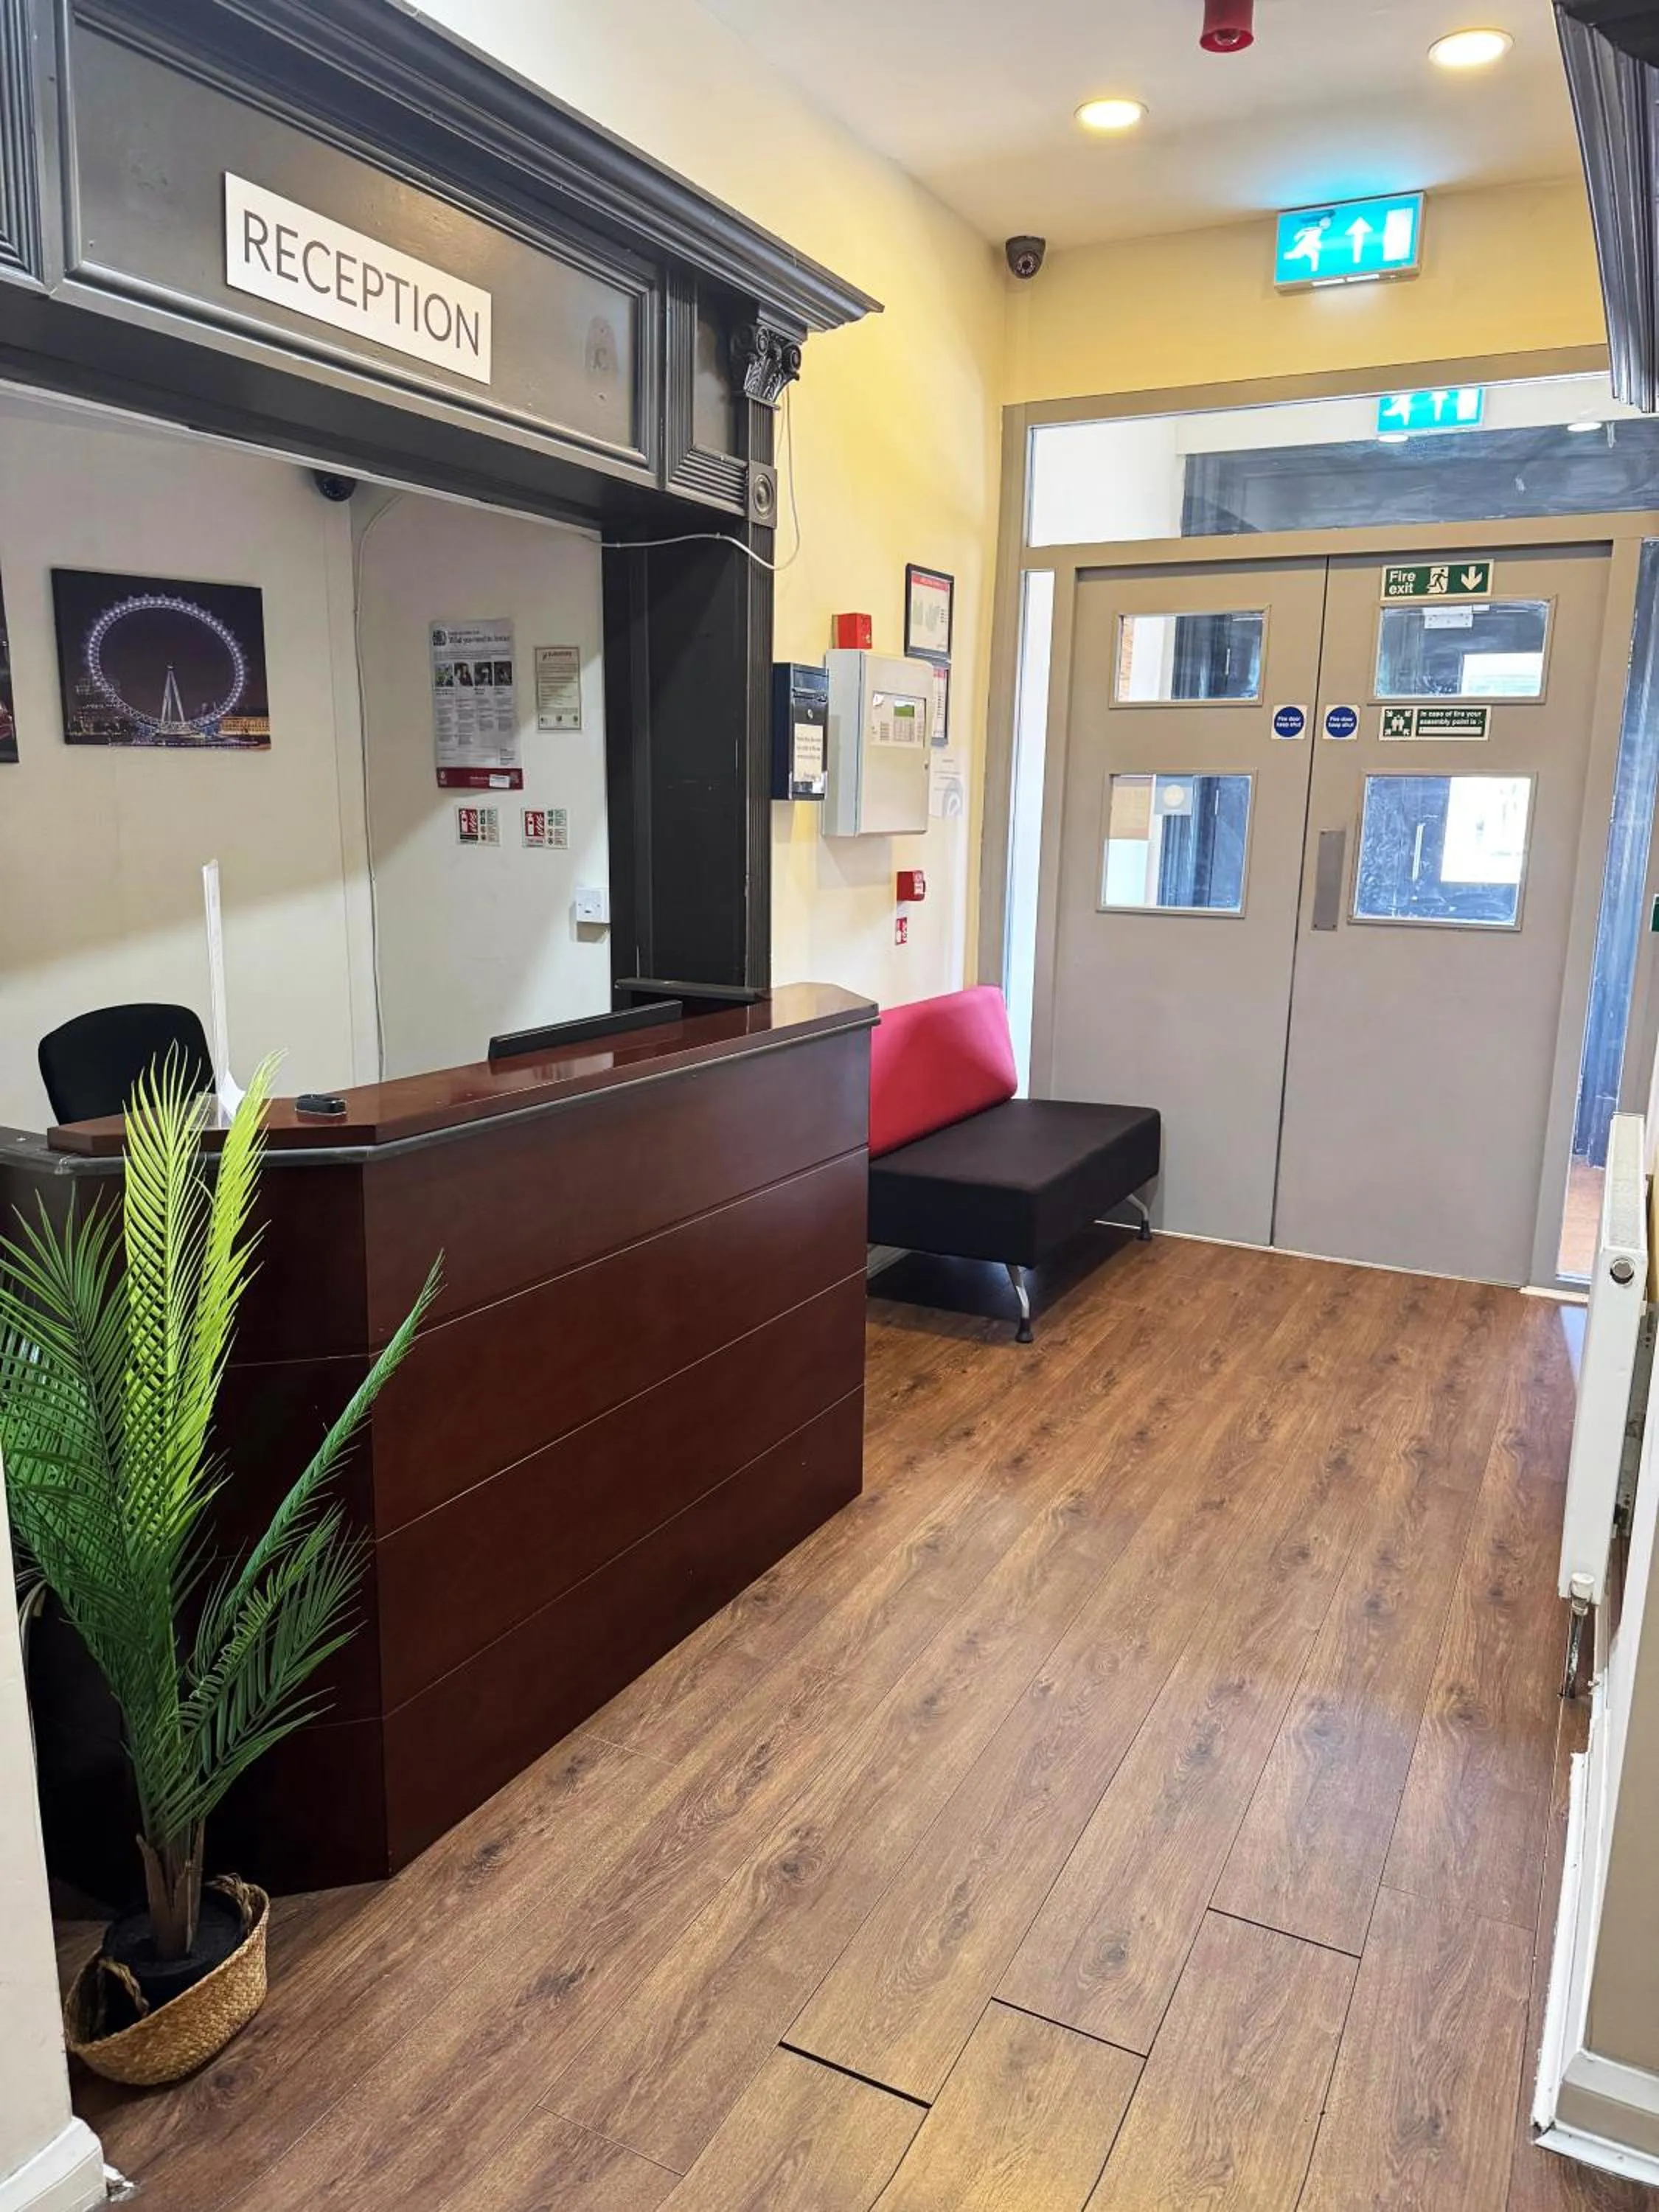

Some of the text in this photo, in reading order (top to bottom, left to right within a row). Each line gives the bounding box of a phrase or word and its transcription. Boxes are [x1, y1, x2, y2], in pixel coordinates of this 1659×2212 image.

[243, 209, 481, 357] RECEPTION
[1389, 570, 1416, 582] Fire
[1388, 582, 1413, 595] exit
[1467, 710, 1481, 719] your
[1419, 717, 1450, 726] assembly
